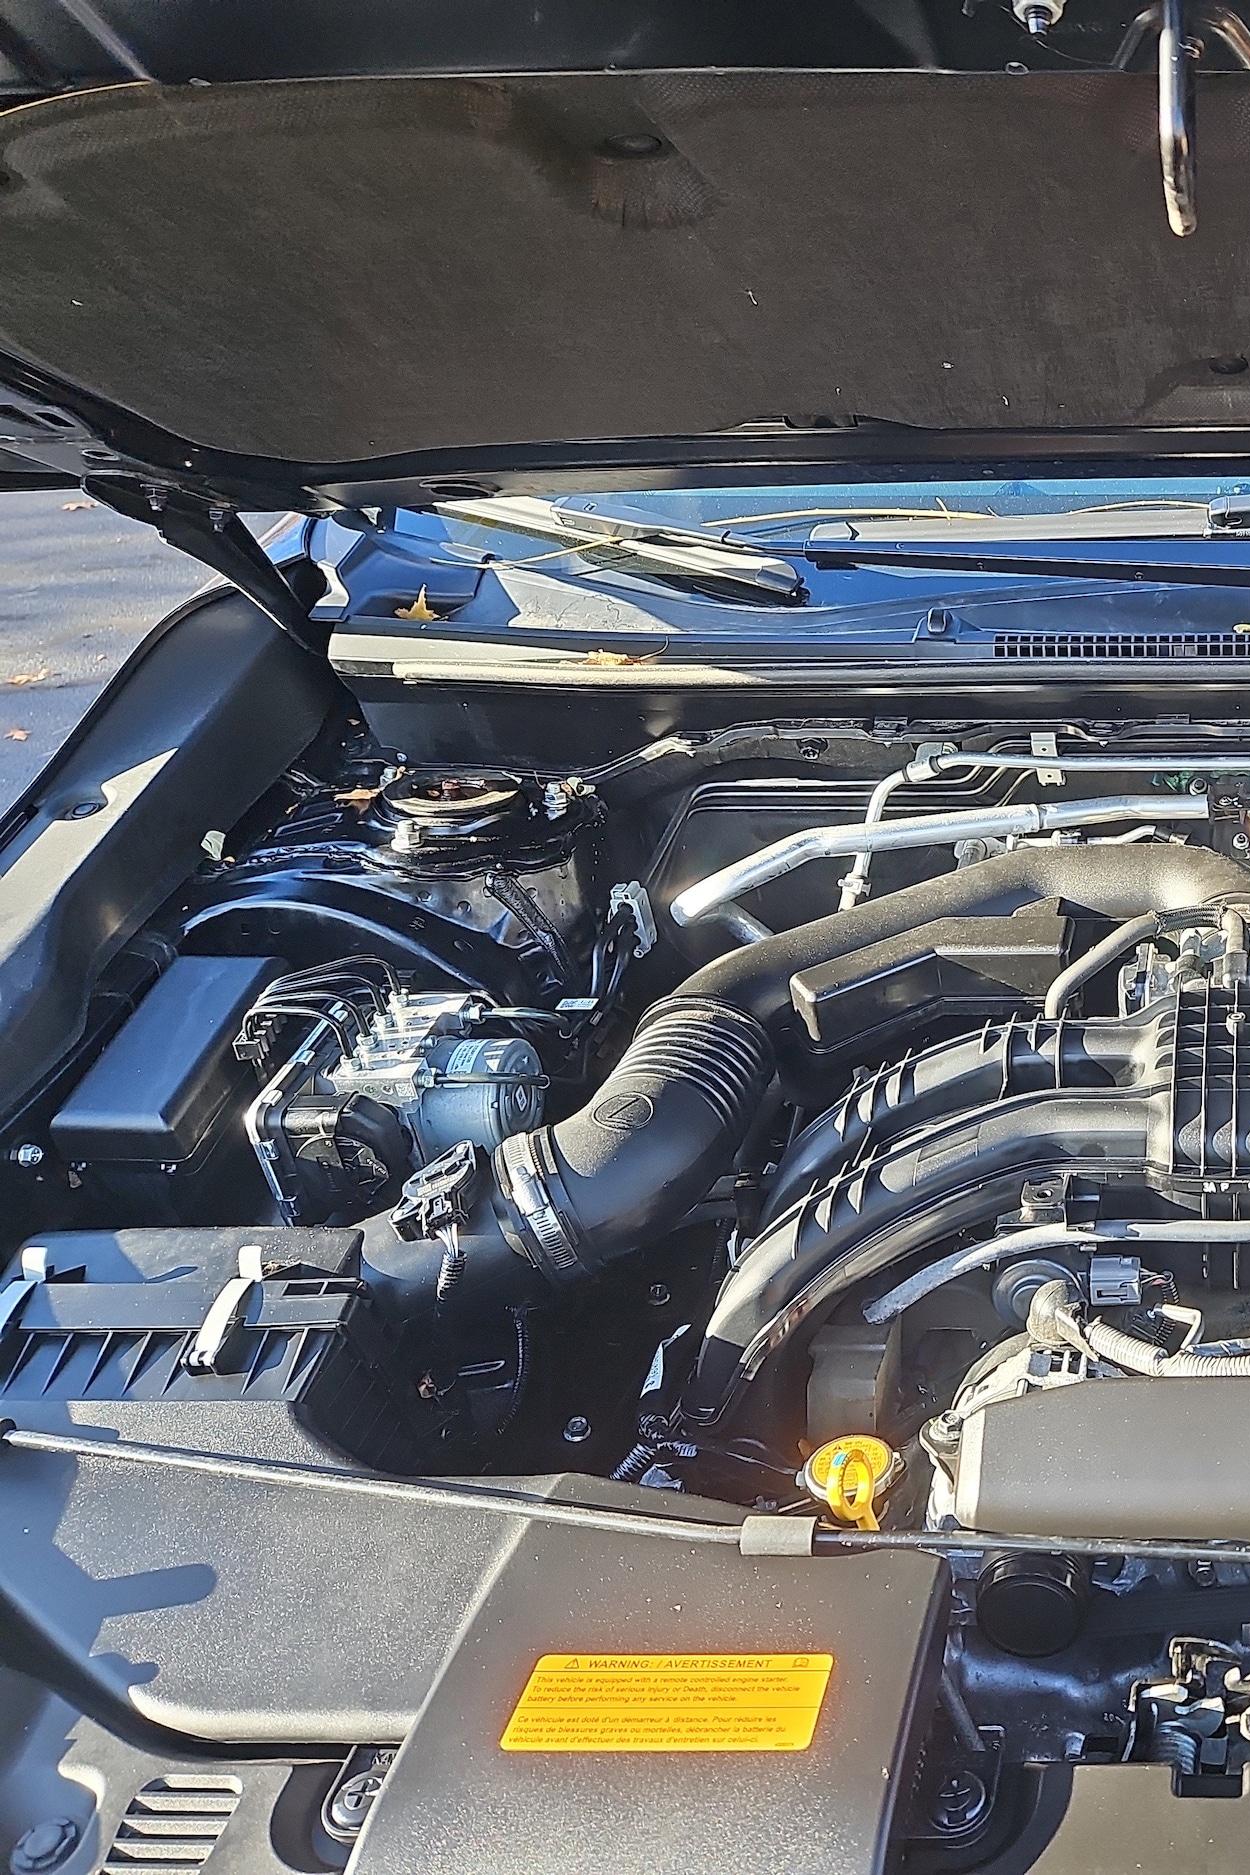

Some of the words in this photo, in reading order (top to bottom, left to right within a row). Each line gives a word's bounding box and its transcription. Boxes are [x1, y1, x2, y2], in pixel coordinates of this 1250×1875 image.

[588, 1659, 653, 1669] WARNING:
[664, 1659, 773, 1669] AVERTISSEMENT
[595, 1676, 633, 1684] equipped
[732, 1676, 759, 1684] engine
[527, 1695, 555, 1703] battery
[585, 1695, 630, 1703] performing
[512, 1726, 543, 1734] risques
